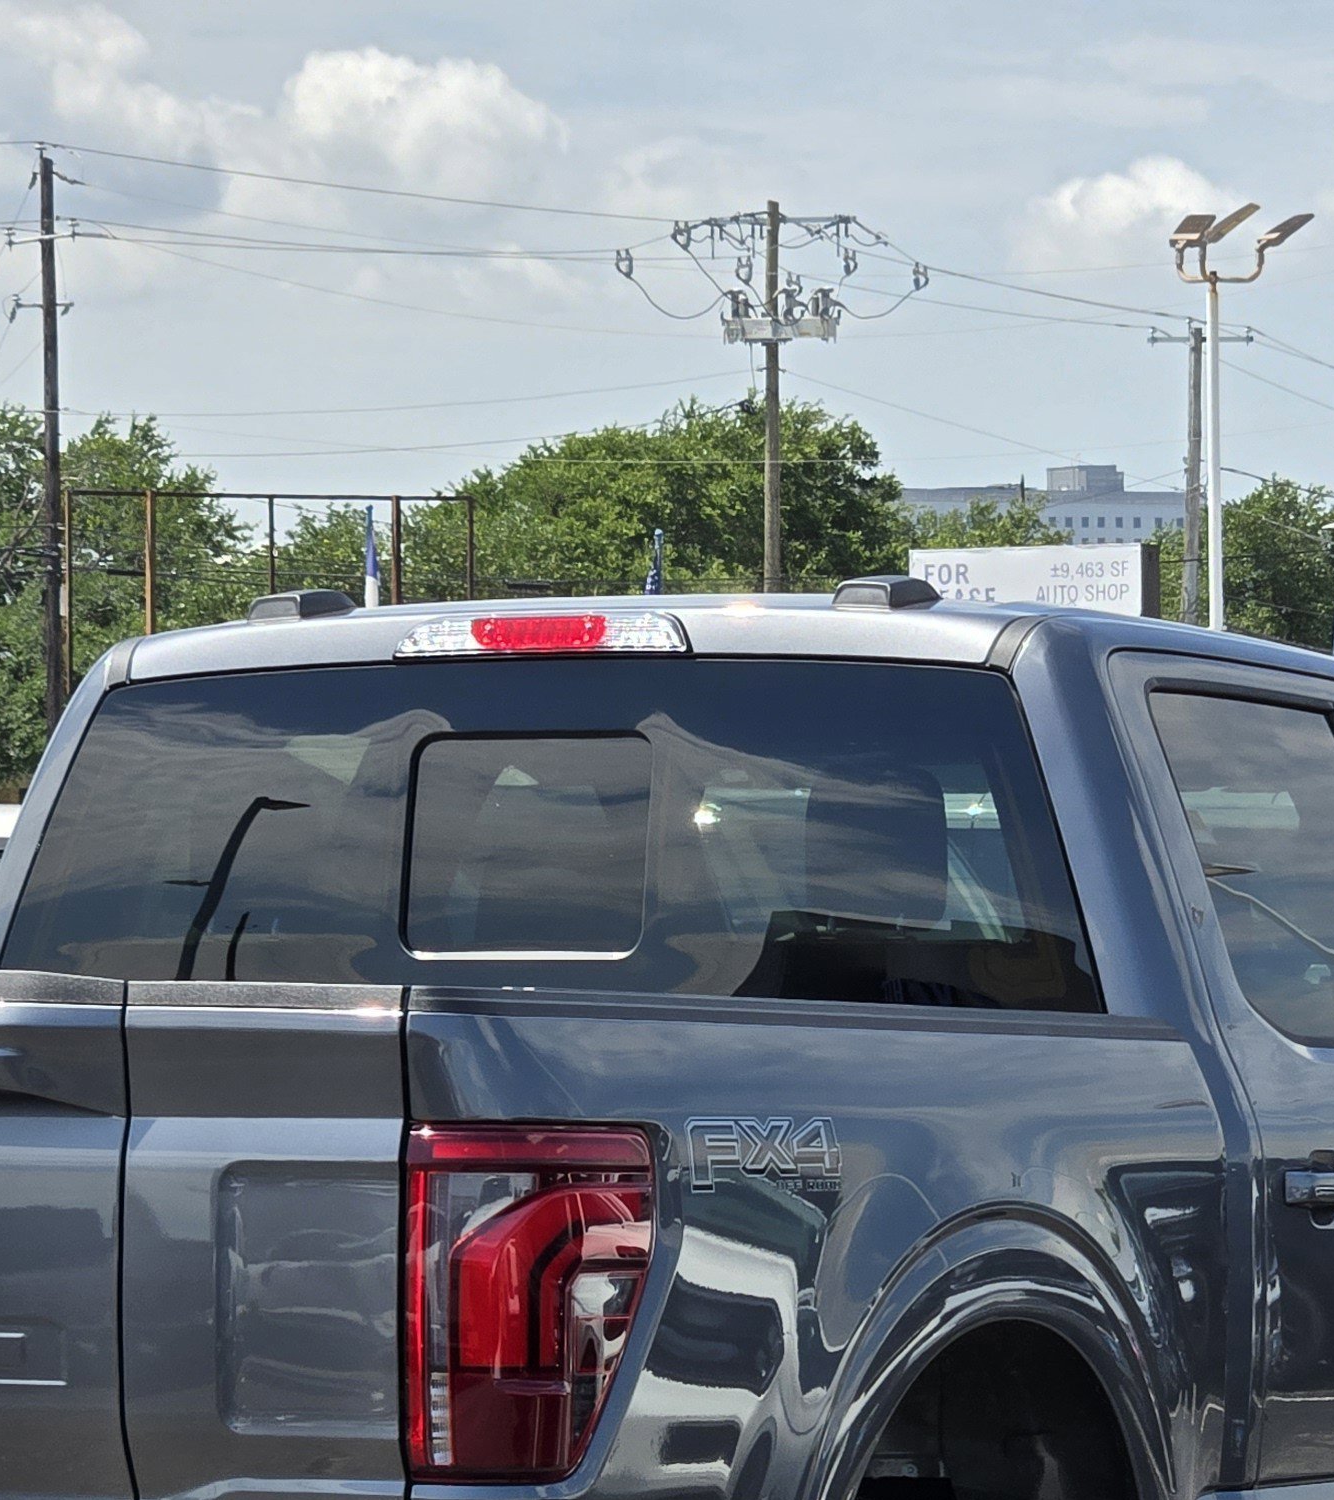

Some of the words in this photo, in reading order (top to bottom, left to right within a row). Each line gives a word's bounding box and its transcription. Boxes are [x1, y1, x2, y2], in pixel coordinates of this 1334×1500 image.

[924, 564, 970, 586] FOR
[1110, 561, 1129, 577] SF
[1084, 584, 1130, 602] SHOP
[684, 1116, 843, 1194] FX4
